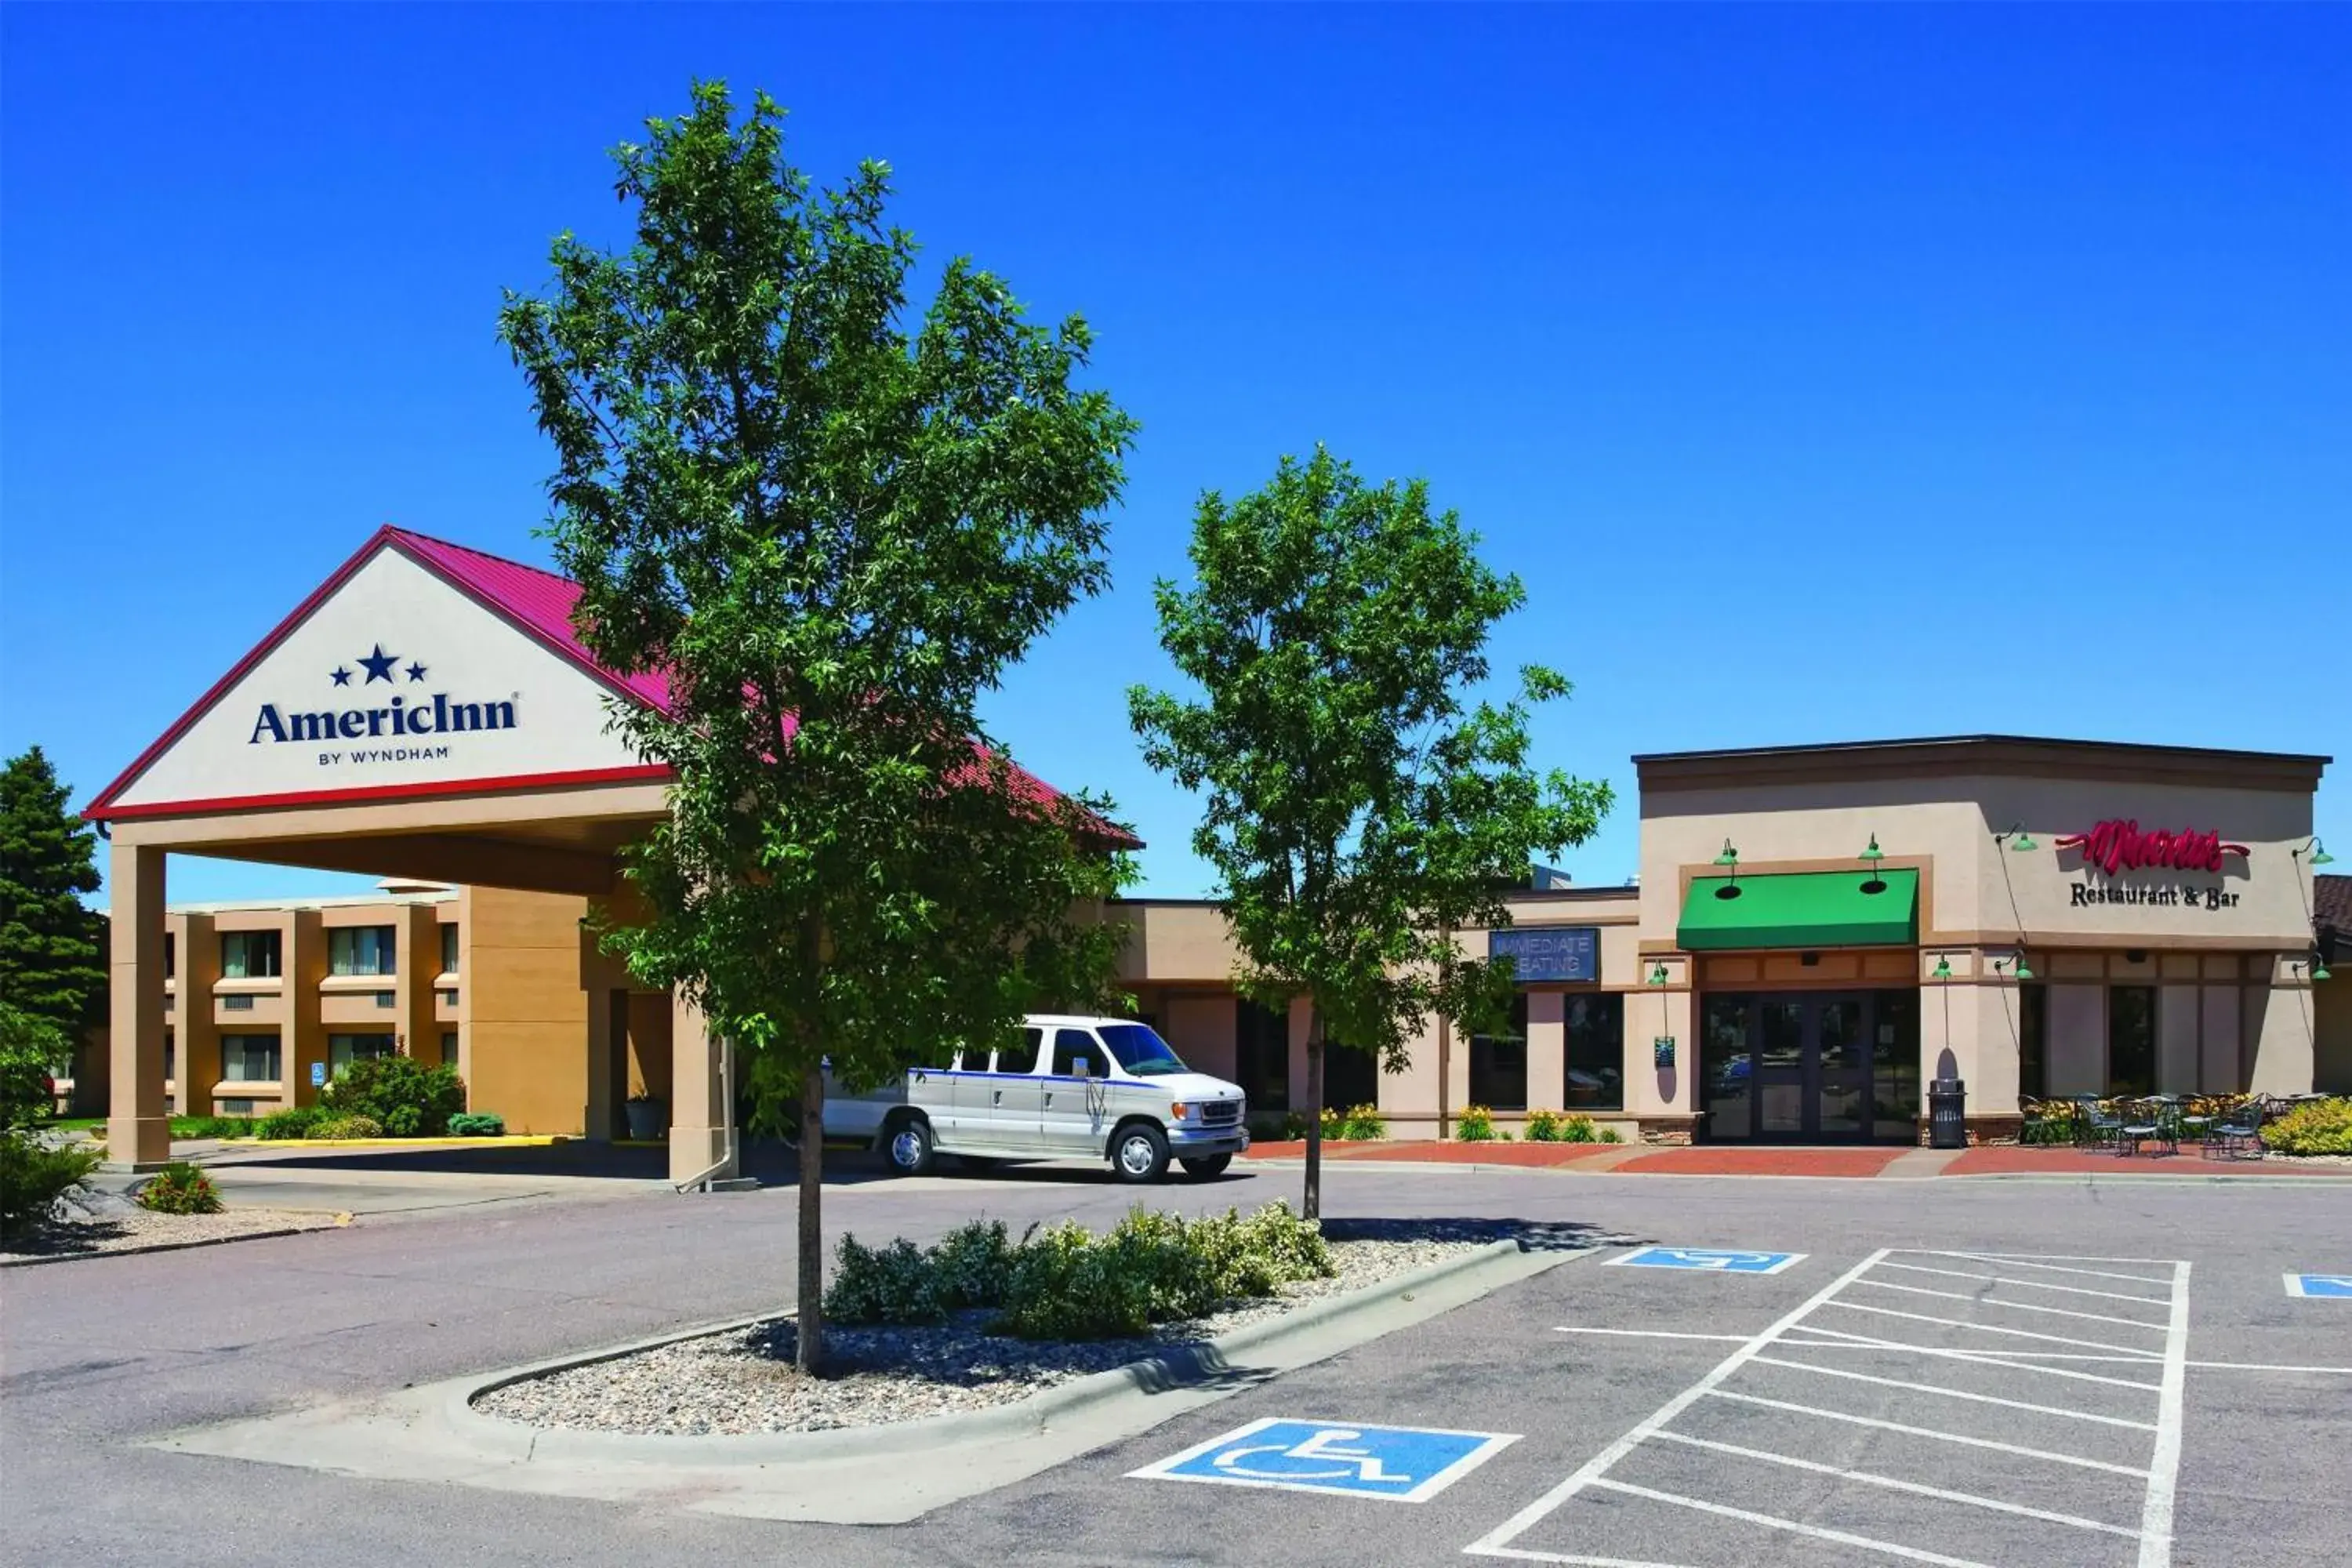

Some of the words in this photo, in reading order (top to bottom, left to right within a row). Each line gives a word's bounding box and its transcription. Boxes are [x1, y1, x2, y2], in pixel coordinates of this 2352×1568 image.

[249, 693, 517, 744] AmericInn
[318, 753, 342, 766] BY
[350, 746, 449, 764] WYNDHAM
[2070, 882, 2178, 907] Restaurant
[2183, 886, 2199, 906] &
[2205, 886, 2240, 911] Bar
[1496, 937, 1591, 955] IMMEDIATE
[1513, 956, 1581, 973] EATING
